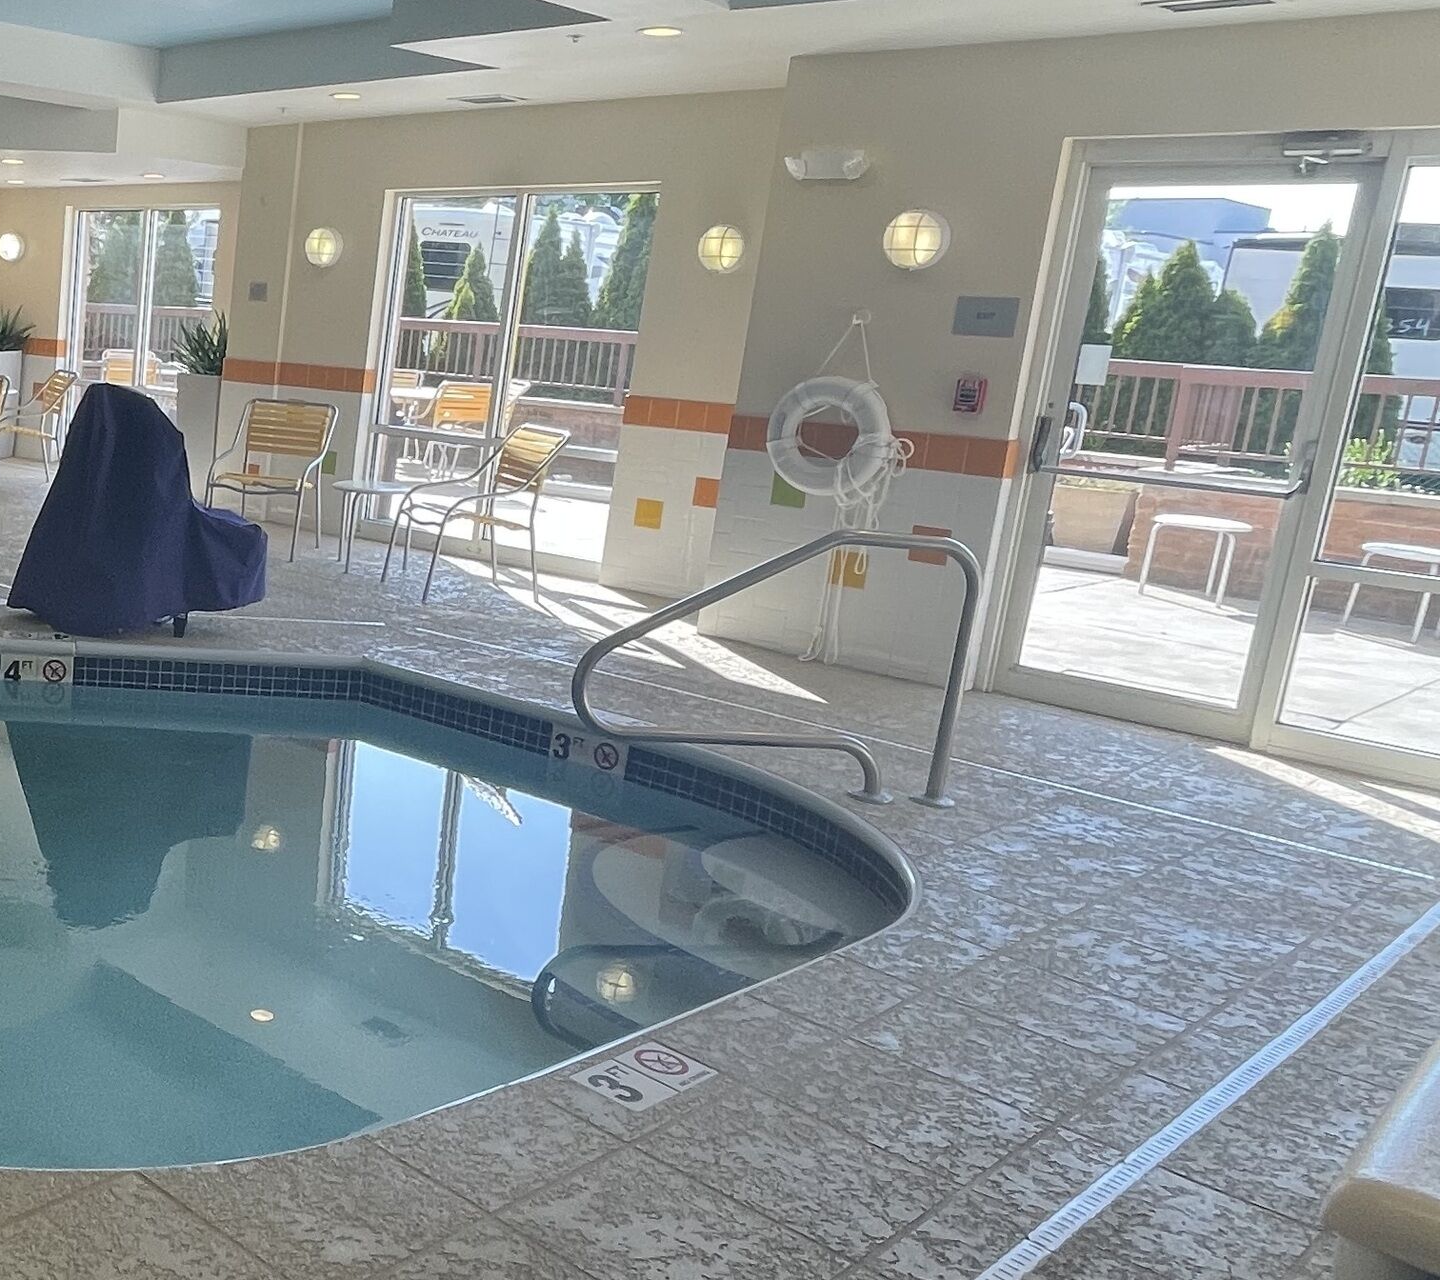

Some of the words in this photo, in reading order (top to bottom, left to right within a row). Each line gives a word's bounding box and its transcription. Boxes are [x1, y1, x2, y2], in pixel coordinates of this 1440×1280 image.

[421, 226, 479, 238] CHATEAU
[4, 660, 21, 681] 4
[22, 660, 33, 670] FT
[553, 733, 571, 760] 3
[604, 1065, 629, 1079] FT
[587, 1074, 644, 1102] 3
